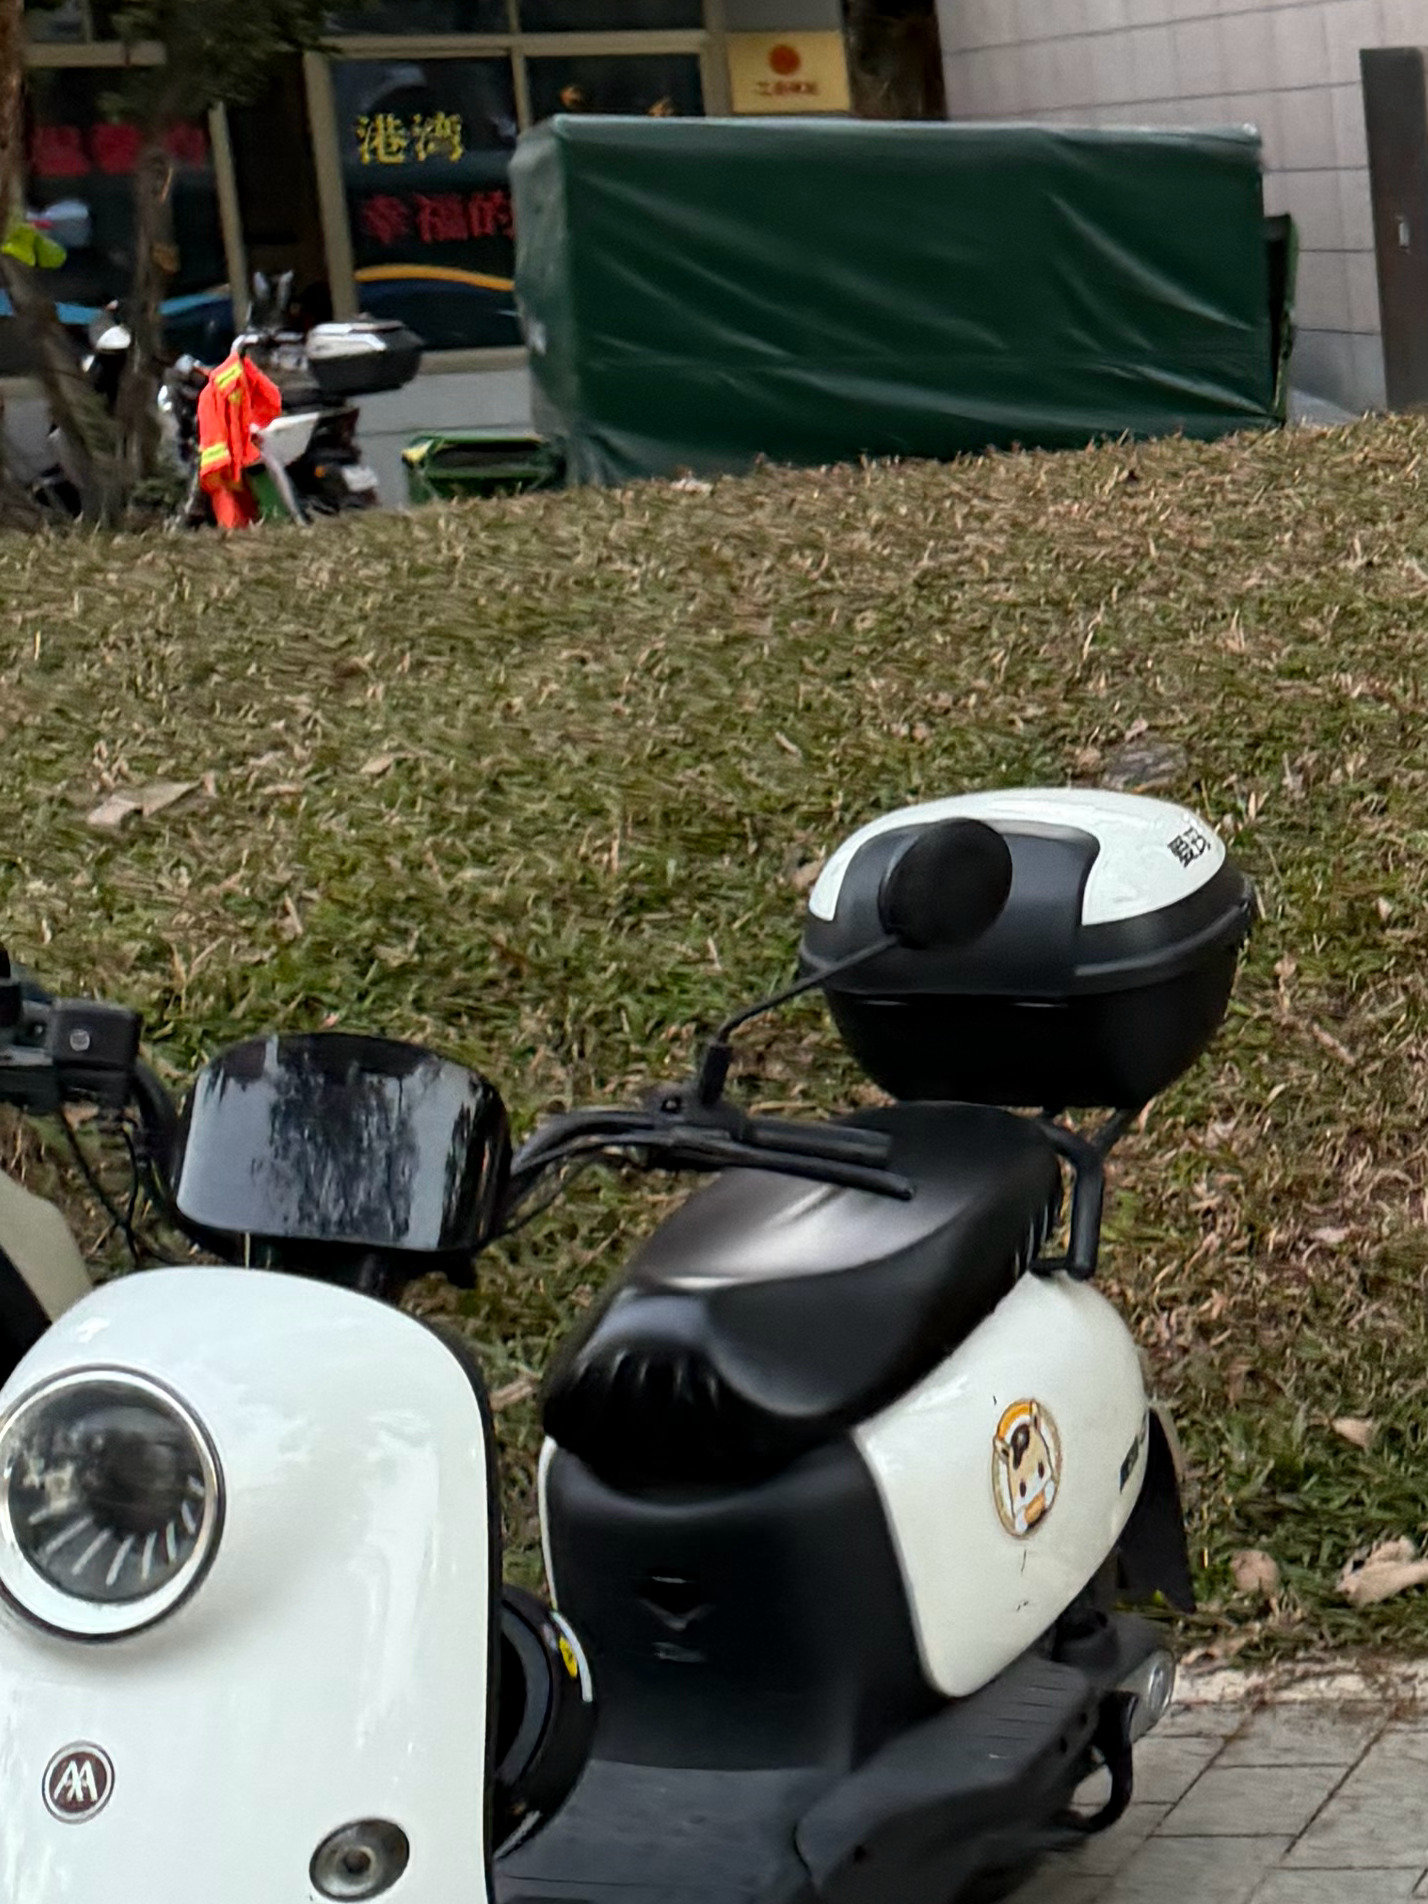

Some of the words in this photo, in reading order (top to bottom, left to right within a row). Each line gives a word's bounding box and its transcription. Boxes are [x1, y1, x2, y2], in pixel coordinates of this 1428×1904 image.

[356, 112, 465, 165] 港湾
[362, 189, 515, 245] 幸福的
